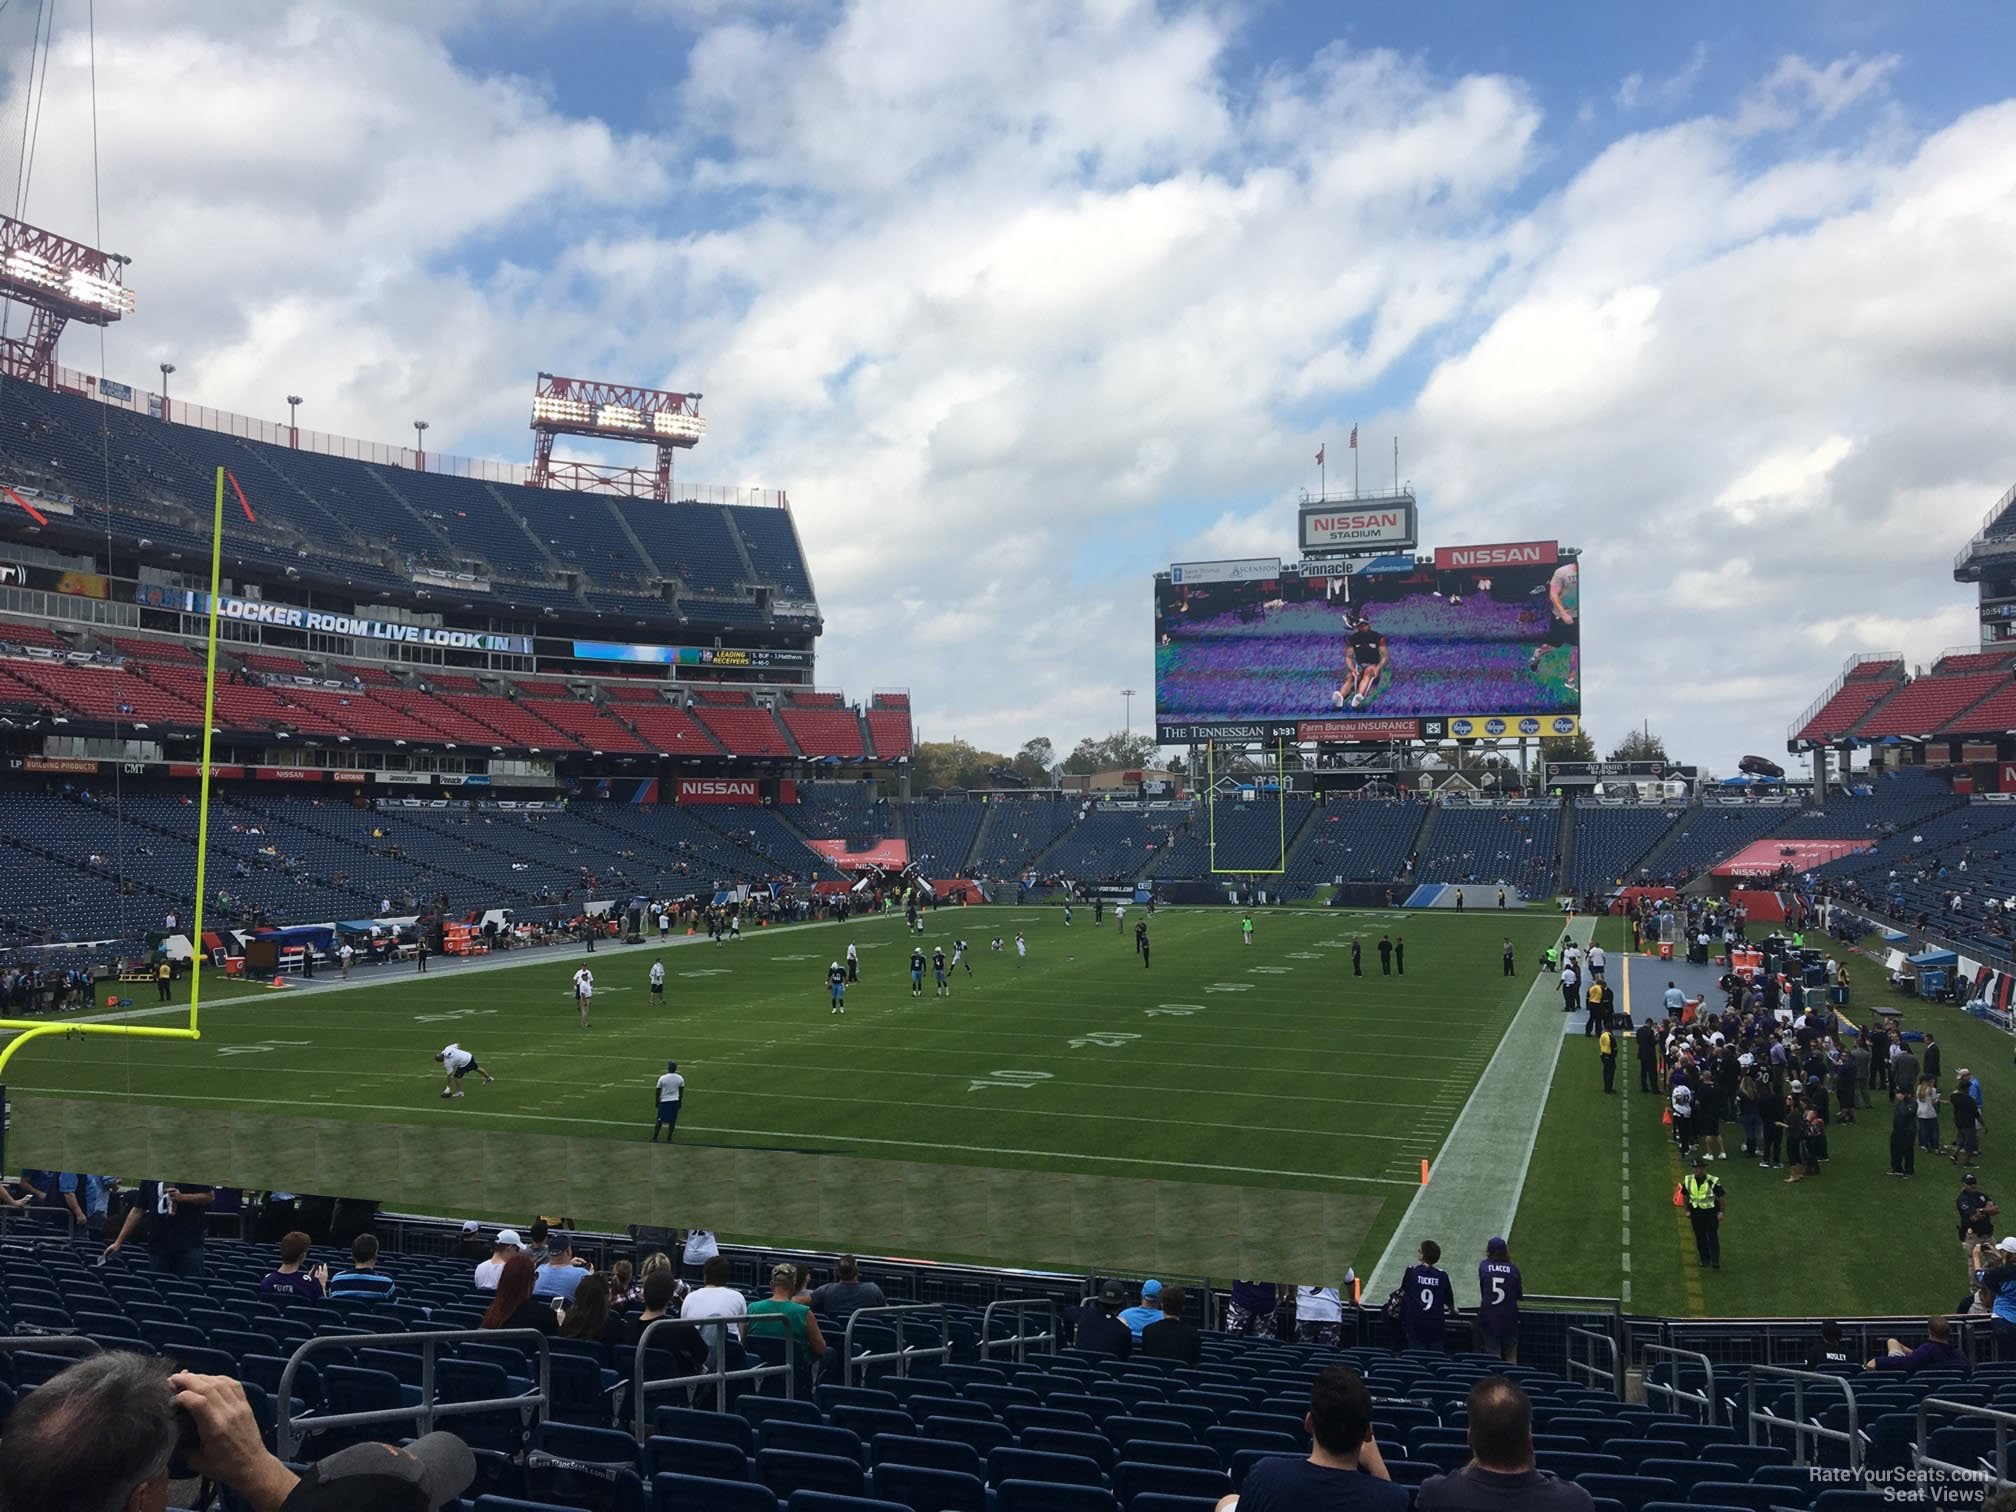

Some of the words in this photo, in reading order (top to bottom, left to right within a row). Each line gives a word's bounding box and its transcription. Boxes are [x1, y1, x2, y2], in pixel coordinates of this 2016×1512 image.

[1314, 513, 1397, 531] NISSAN
[1330, 529, 1381, 540] STADIUM
[1452, 547, 1541, 565] NISSAN
[1232, 564, 1277, 577] ASCENSION
[1300, 562, 1353, 576] Pinnacle
[217, 597, 301, 627] LOCKER
[306, 612, 368, 636] ROOM
[374, 623, 419, 643] LIVE
[423, 628, 483, 650] LOOK
[488, 635, 511, 651] IN
[1163, 727, 1187, 738] THE
[1190, 726, 1264, 738] TENNESSEAN
[1300, 723, 1323, 732] Farm
[1325, 722, 1356, 731] Bureau
[1358, 721, 1416, 731] INSURANCE
[1454, 722, 1472, 735] Kroger
[1486, 721, 1505, 734] Kroger
[1520, 721, 1539, 732] Kroger
[1554, 720, 1573, 732] Kroger
[10, 760, 22, 768] LP
[27, 761, 59, 769] BUILDING
[61, 762, 96, 770] PRODUCTS
[124, 763, 145, 774] CMT
[682, 782, 755, 795] NISSAN
[1731, 868, 1771, 877] NISSAN
[1067, 1032, 1143, 1049] 20
[968, 1070, 1055, 1092] 10
[1488, 1265, 1511, 1273] FLACCO
[1417, 1276, 1440, 1286] TUCKER
[1491, 1277, 1505, 1305] 5
[1420, 1289, 1434, 1311] 9
